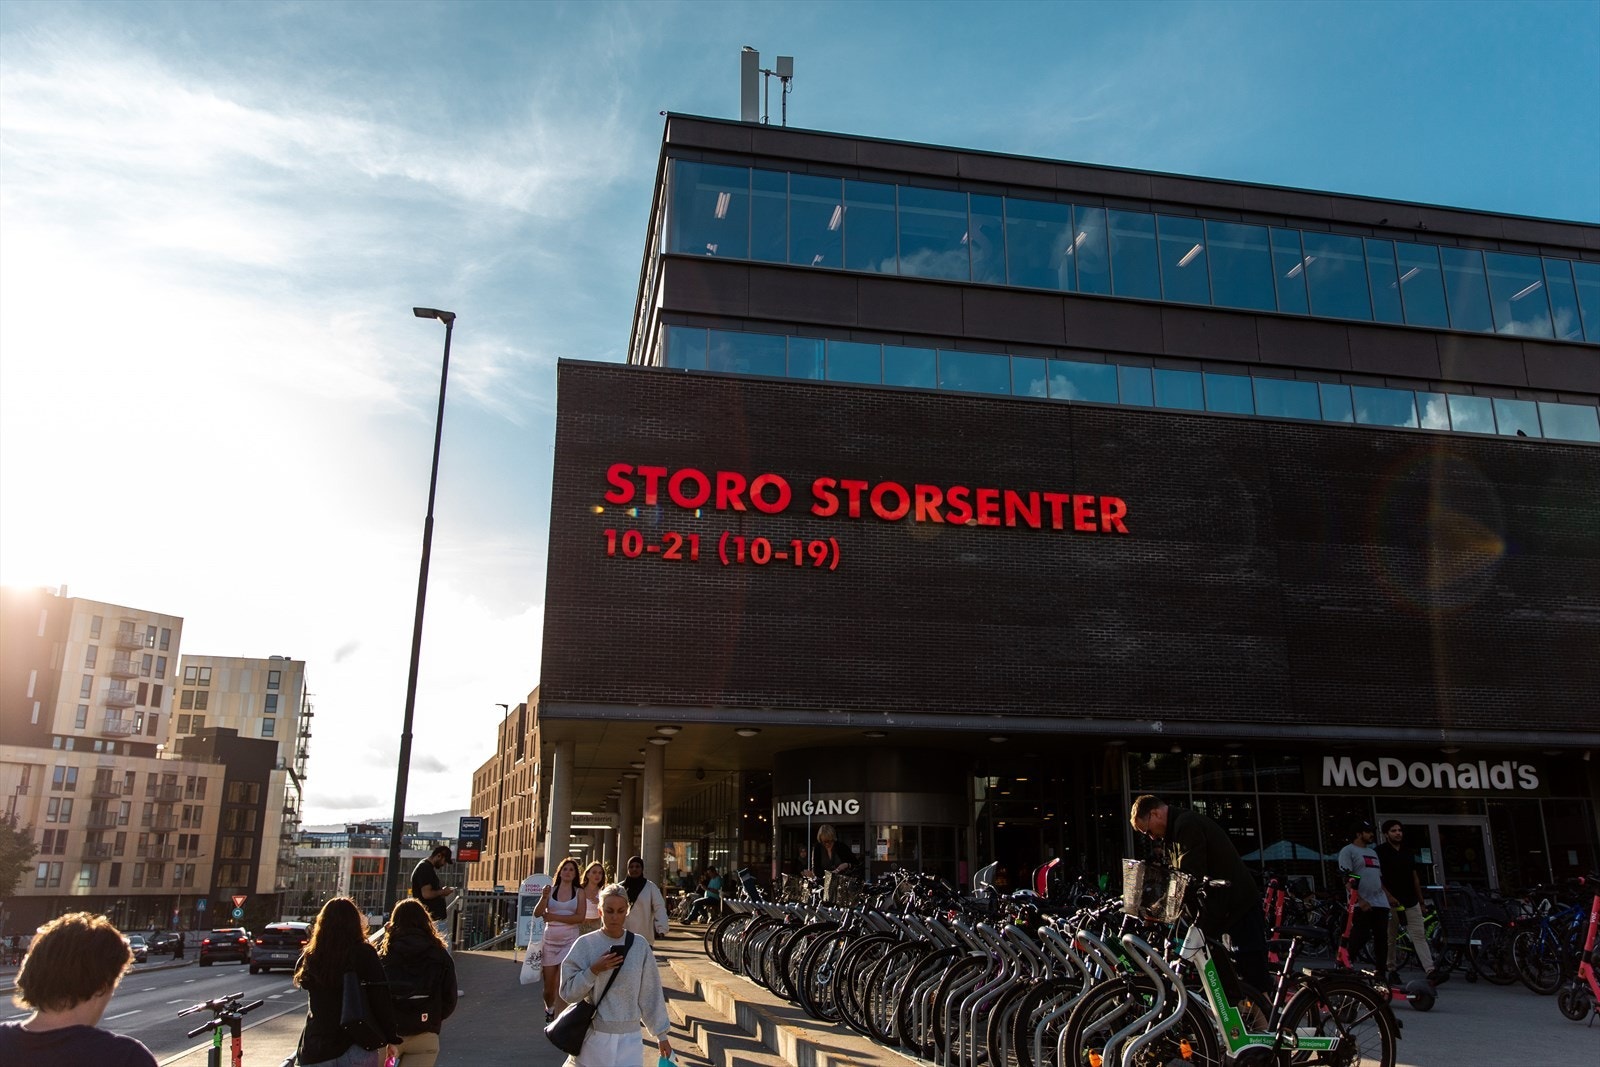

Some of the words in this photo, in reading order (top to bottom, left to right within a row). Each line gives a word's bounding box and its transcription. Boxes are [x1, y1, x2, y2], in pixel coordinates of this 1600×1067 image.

[604, 463, 792, 513] STORO
[811, 477, 1130, 534] STORSENTER
[603, 529, 701, 561] 10-21
[718, 531, 841, 571] (10-19)
[1322, 756, 1540, 790] McDonald's
[777, 799, 860, 817] INNGANG
[1207, 970, 1216, 988] Oslo
[1213, 987, 1229, 1022] kommune
